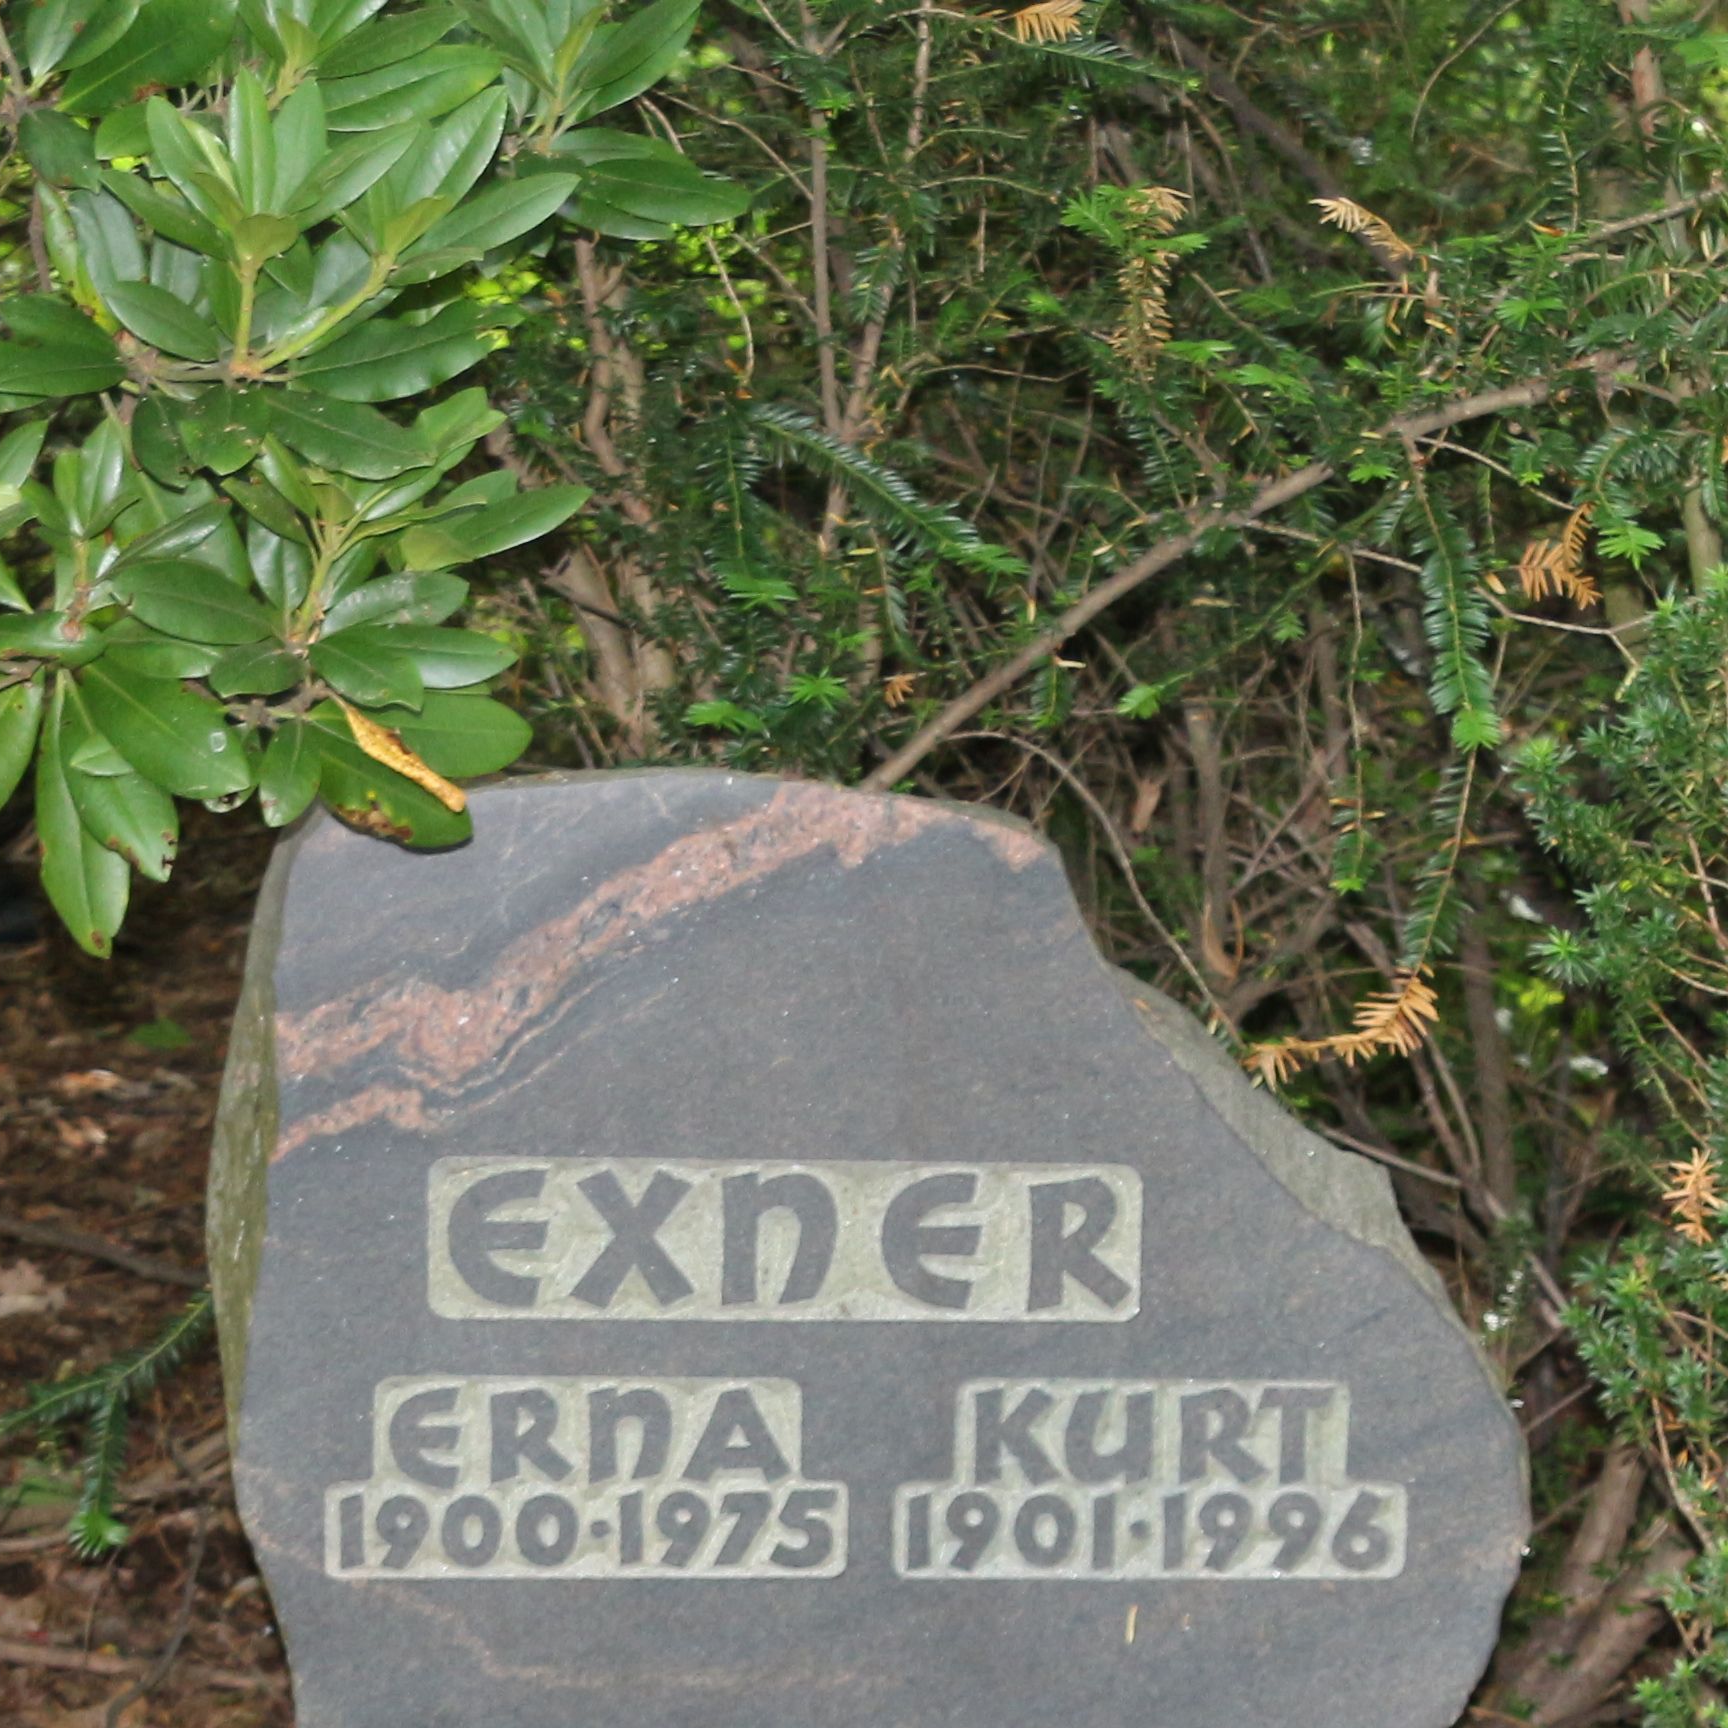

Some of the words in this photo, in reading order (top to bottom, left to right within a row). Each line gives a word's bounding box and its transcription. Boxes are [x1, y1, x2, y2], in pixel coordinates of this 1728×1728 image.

[445, 1168, 1133, 1315] EXNER
[386, 1384, 791, 1491] ERNA
[971, 1384, 1340, 1486] KURT
